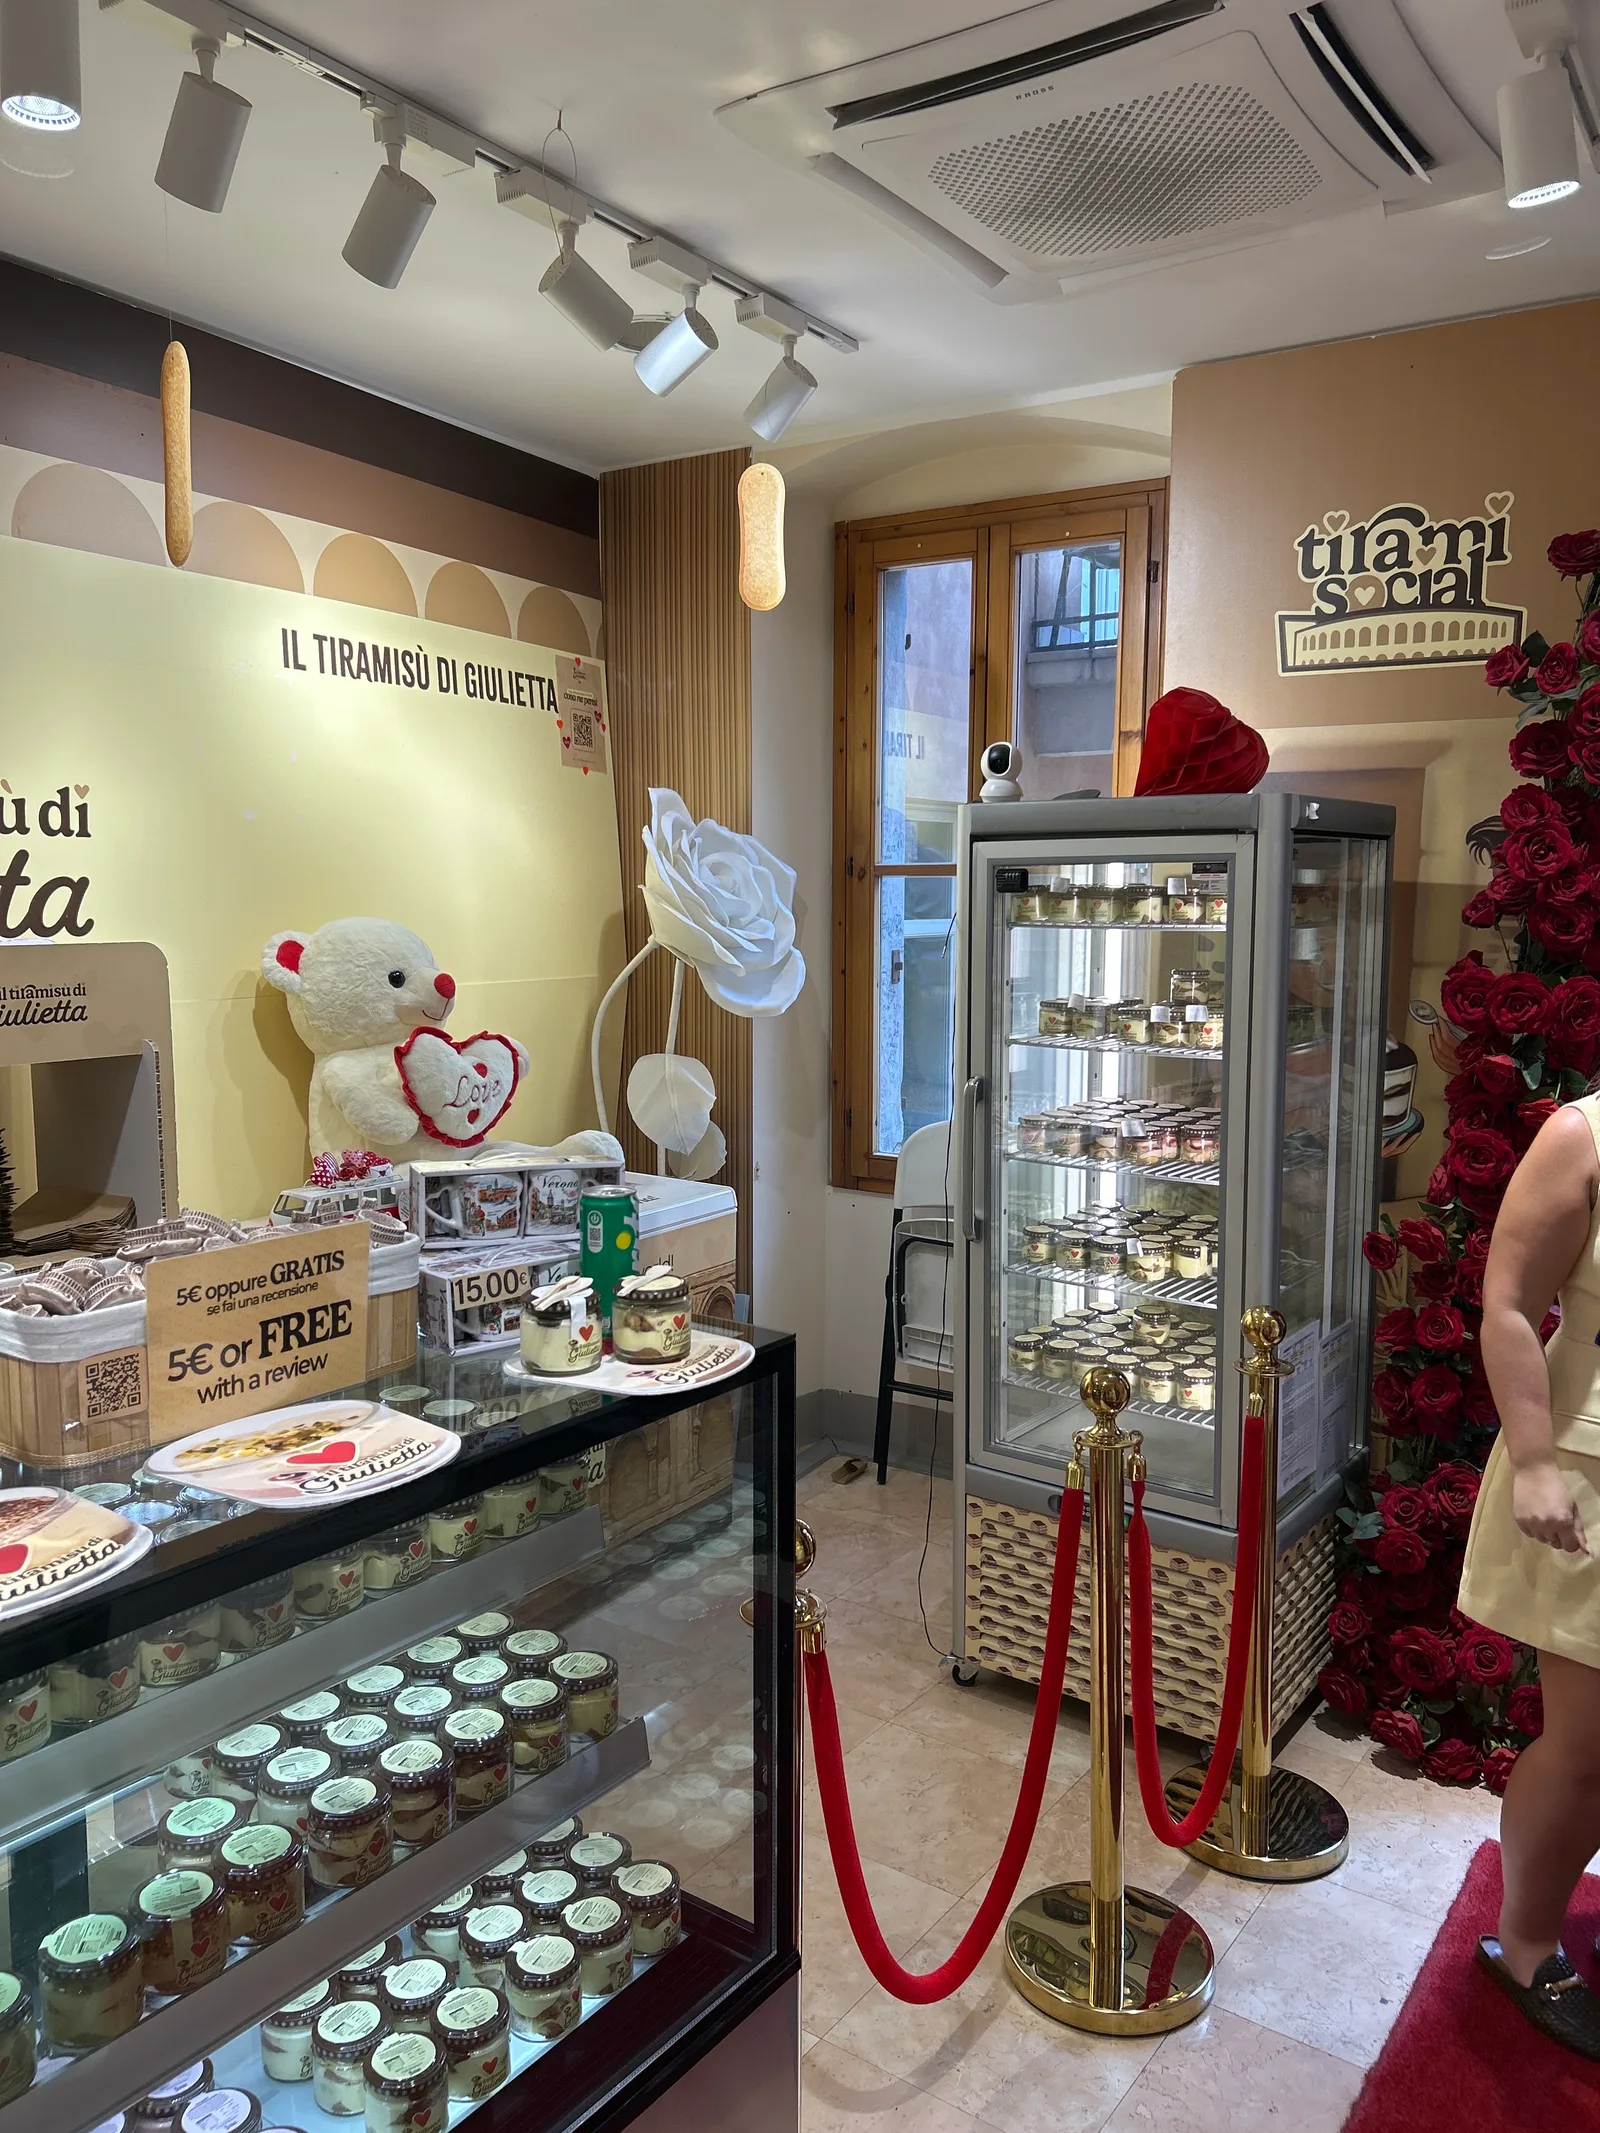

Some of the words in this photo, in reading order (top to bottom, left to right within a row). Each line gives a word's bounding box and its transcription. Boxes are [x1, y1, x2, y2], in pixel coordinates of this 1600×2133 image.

[1295, 494, 1514, 580] tirami
[281, 628, 307, 671] IL
[312, 633, 430, 691] TIRAMISÙ
[436, 656, 459, 695] DI
[464, 662, 560, 714] GIULIETTA
[38, 784, 92, 838] di
[9, 983, 71, 1000] tiramisù
[73, 982, 87, 996] di
[442, 1075, 501, 1107] Love
[176, 1285, 202, 1306] 5€
[205, 1274, 268, 1302] oppure
[270, 1250, 345, 1285] GRATIS
[206, 1305, 221, 1316] se
[222, 1300, 236, 1314] fai
[237, 1296, 260, 1309] una
[261, 1281, 319, 1304] recensione
[454, 1267, 528, 1304] 15,00€
[167, 1343, 214, 1382] 5€
[220, 1338, 253, 1368] or
[258, 1299, 353, 1359] FREE
[654, 1347, 736, 1385] Giulietta
[197, 1374, 245, 1404] with
[248, 1373, 260, 1390] a
[265, 1353, 329, 1384] review
[299, 1441, 432, 1495] Giulietta
